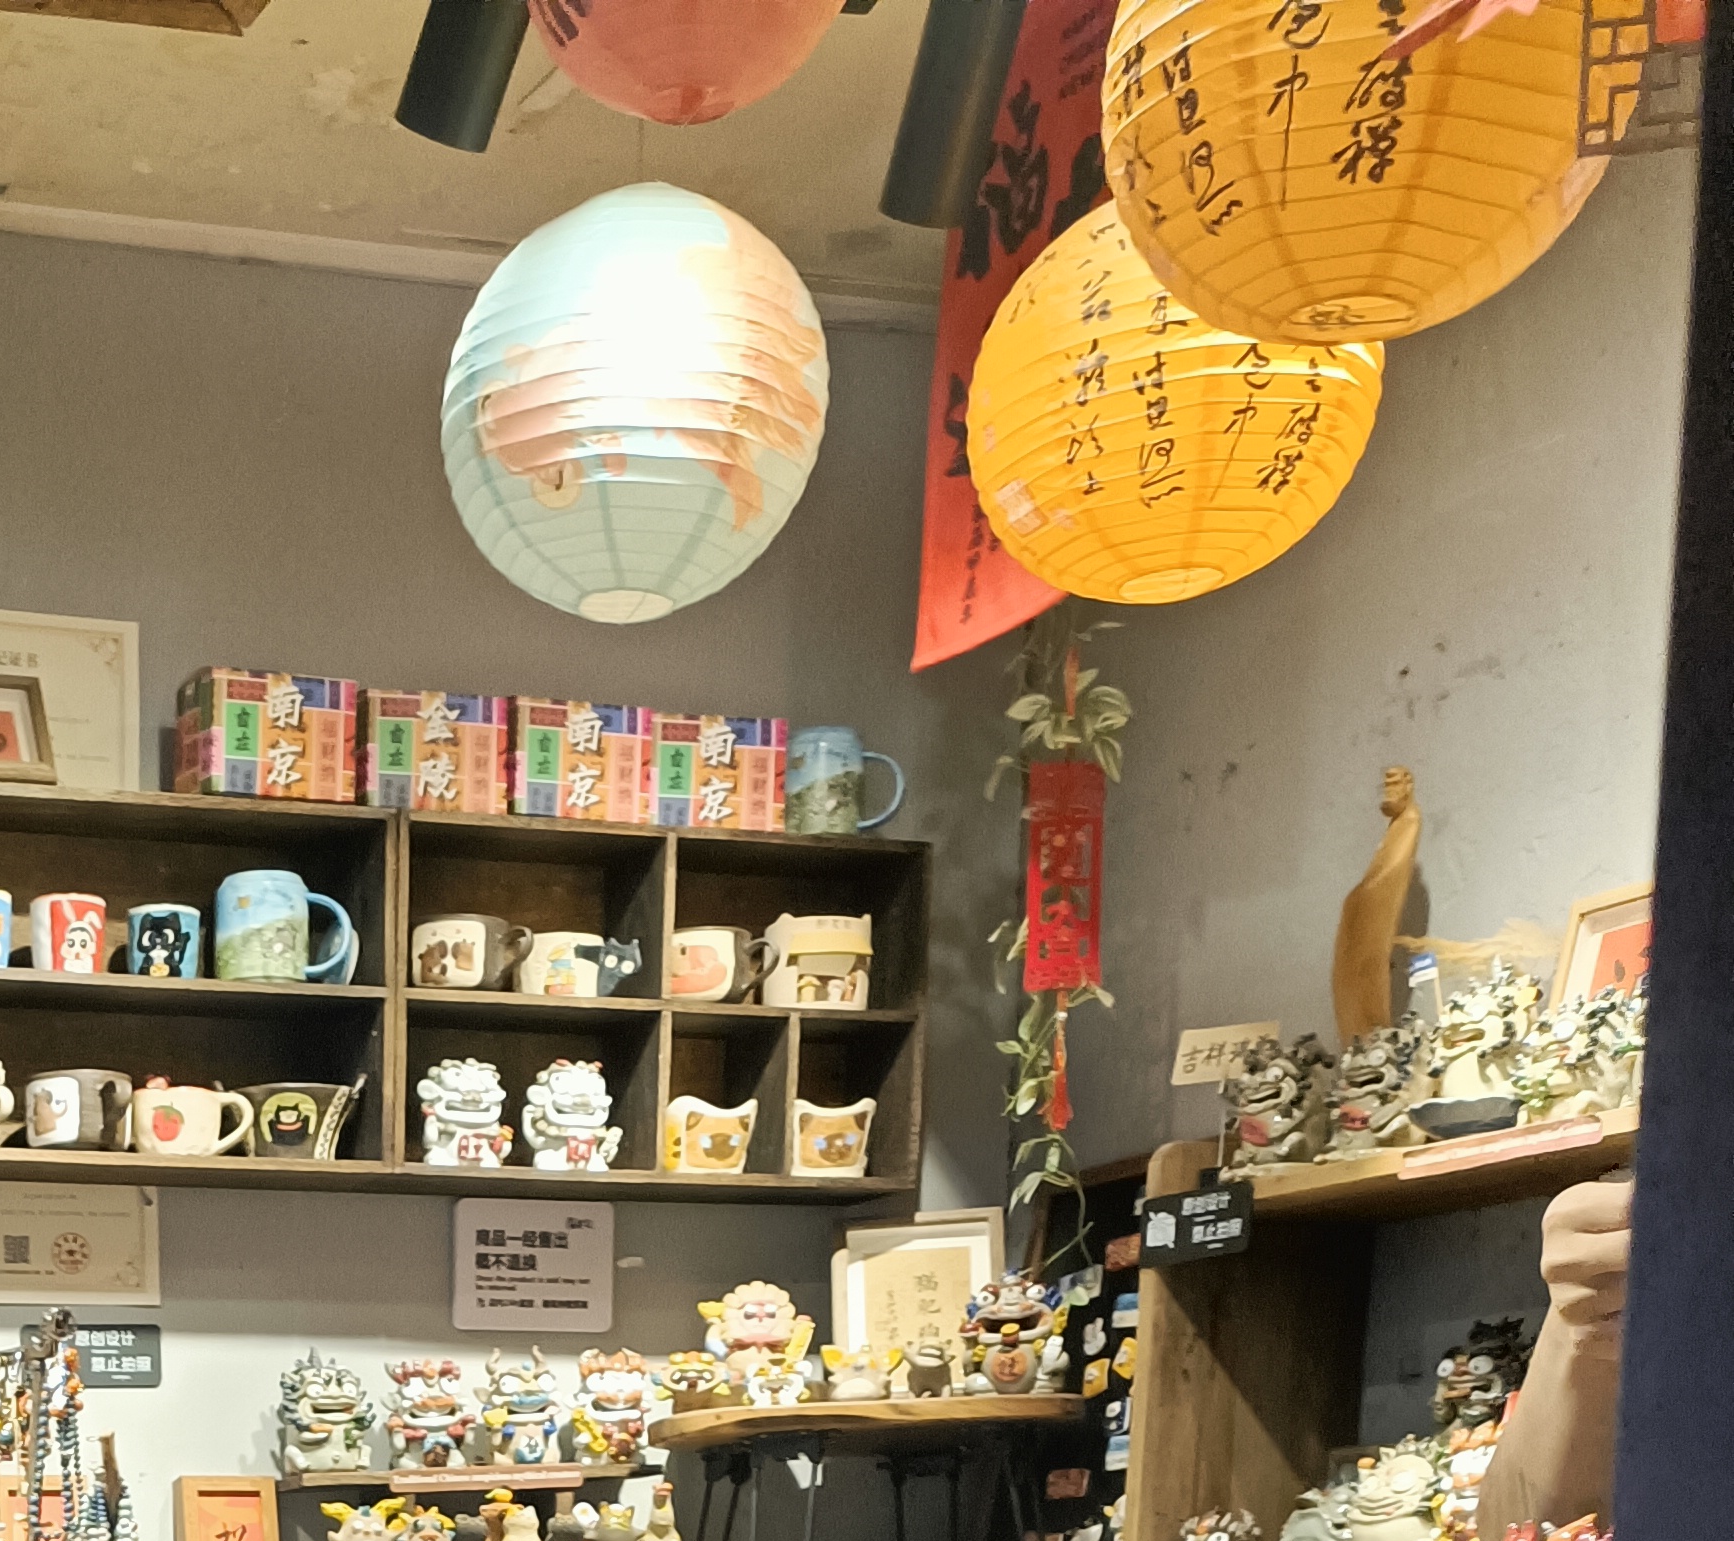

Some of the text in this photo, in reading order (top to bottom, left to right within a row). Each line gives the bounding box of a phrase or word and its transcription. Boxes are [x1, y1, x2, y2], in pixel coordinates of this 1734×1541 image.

[264, 683, 305, 787] 南京
[416, 700, 461, 801] 金陵
[564, 709, 604, 808] 南京
[697, 725, 738, 821] 南京
